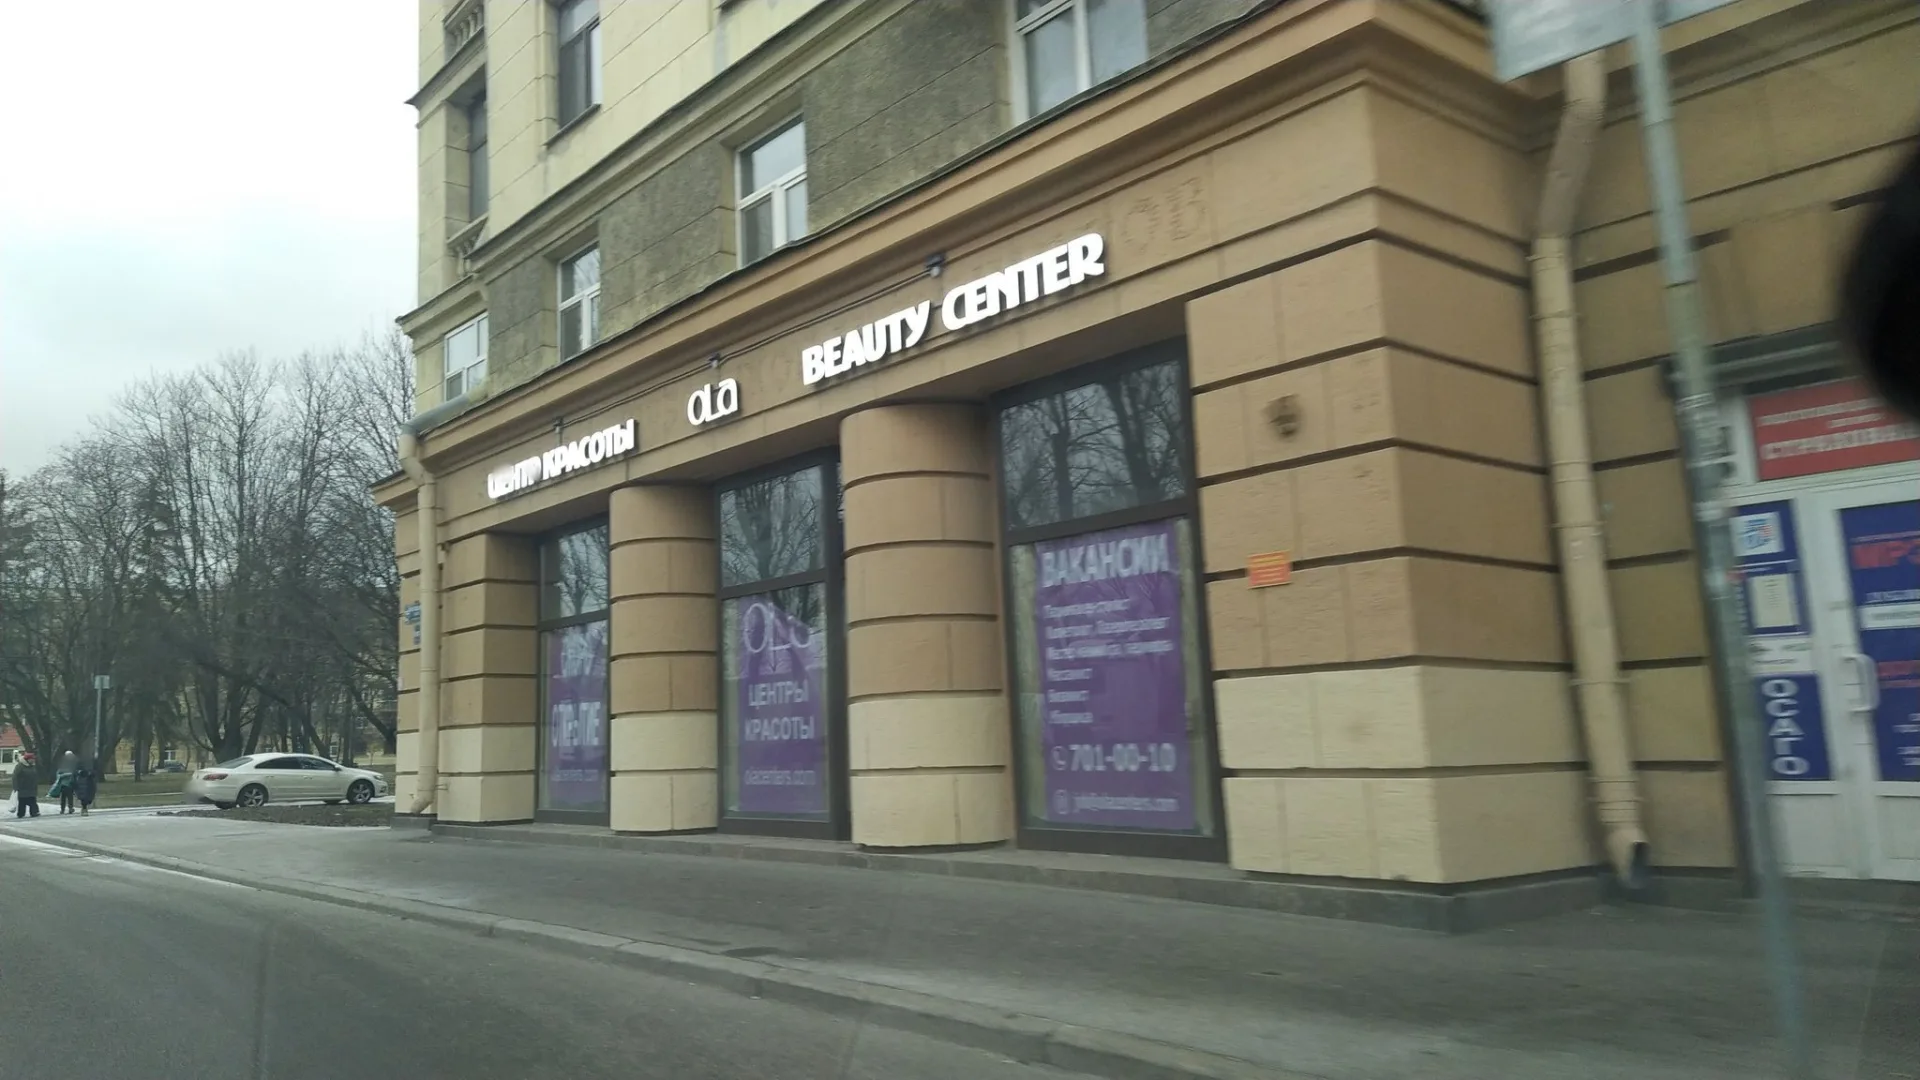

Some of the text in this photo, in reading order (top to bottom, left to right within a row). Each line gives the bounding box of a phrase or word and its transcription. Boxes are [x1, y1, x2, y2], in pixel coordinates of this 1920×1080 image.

[802, 233, 1104, 385] BEAUTY CENTER
[543, 418, 635, 480] КРАСОТЫ
[1042, 533, 1168, 588] ВАКАНСИИ
[749, 678, 809, 709] ЦЕНТРЫ
[745, 716, 815, 741] КРАСОТЫ
[1761, 679, 1811, 775] ОСАГО
[1068, 743, 1177, 772] 701-00-10
